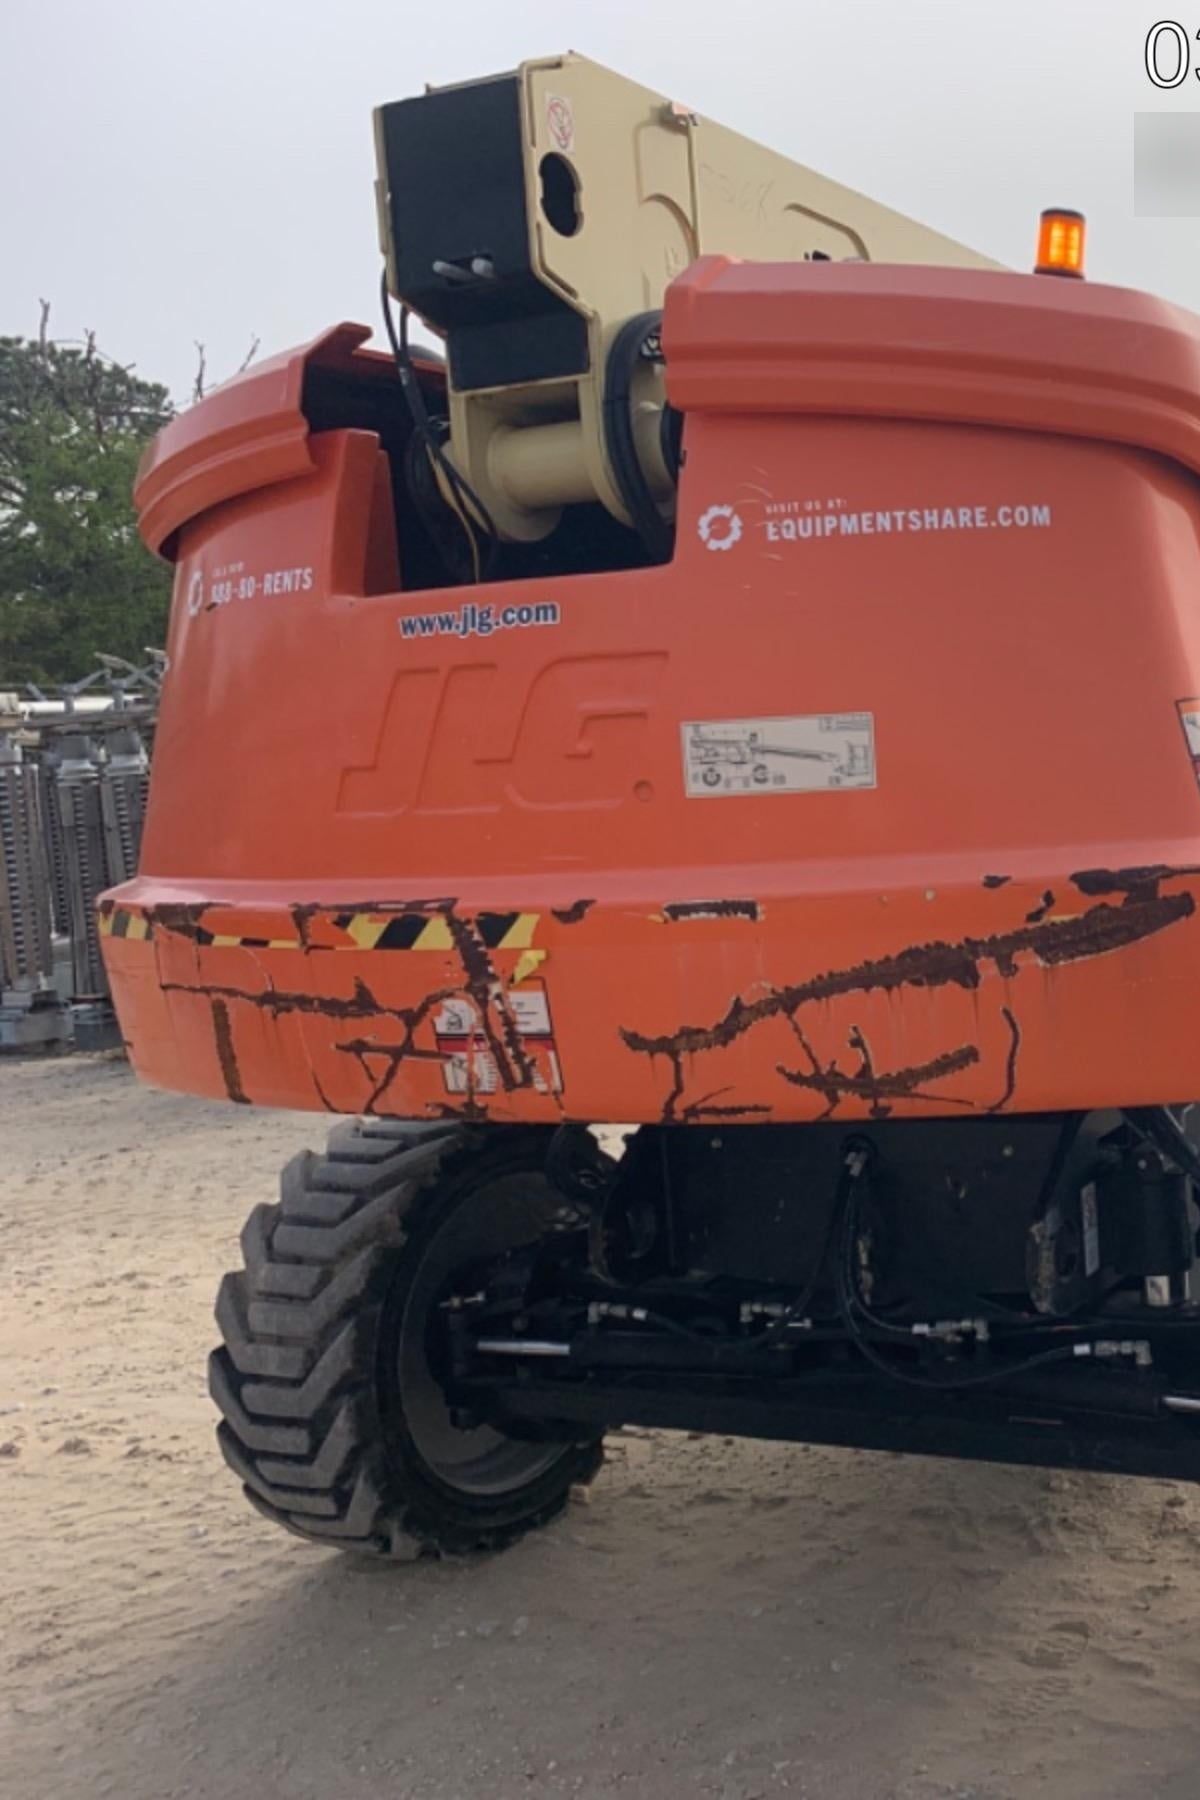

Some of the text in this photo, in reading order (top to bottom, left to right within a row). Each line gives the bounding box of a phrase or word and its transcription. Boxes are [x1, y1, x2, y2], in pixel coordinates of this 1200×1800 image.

[766, 504, 1051, 542] EQUIPMENTSHARE.COM
[400, 601, 560, 639] www.jlg.com
[336, 650, 670, 818] JLG
